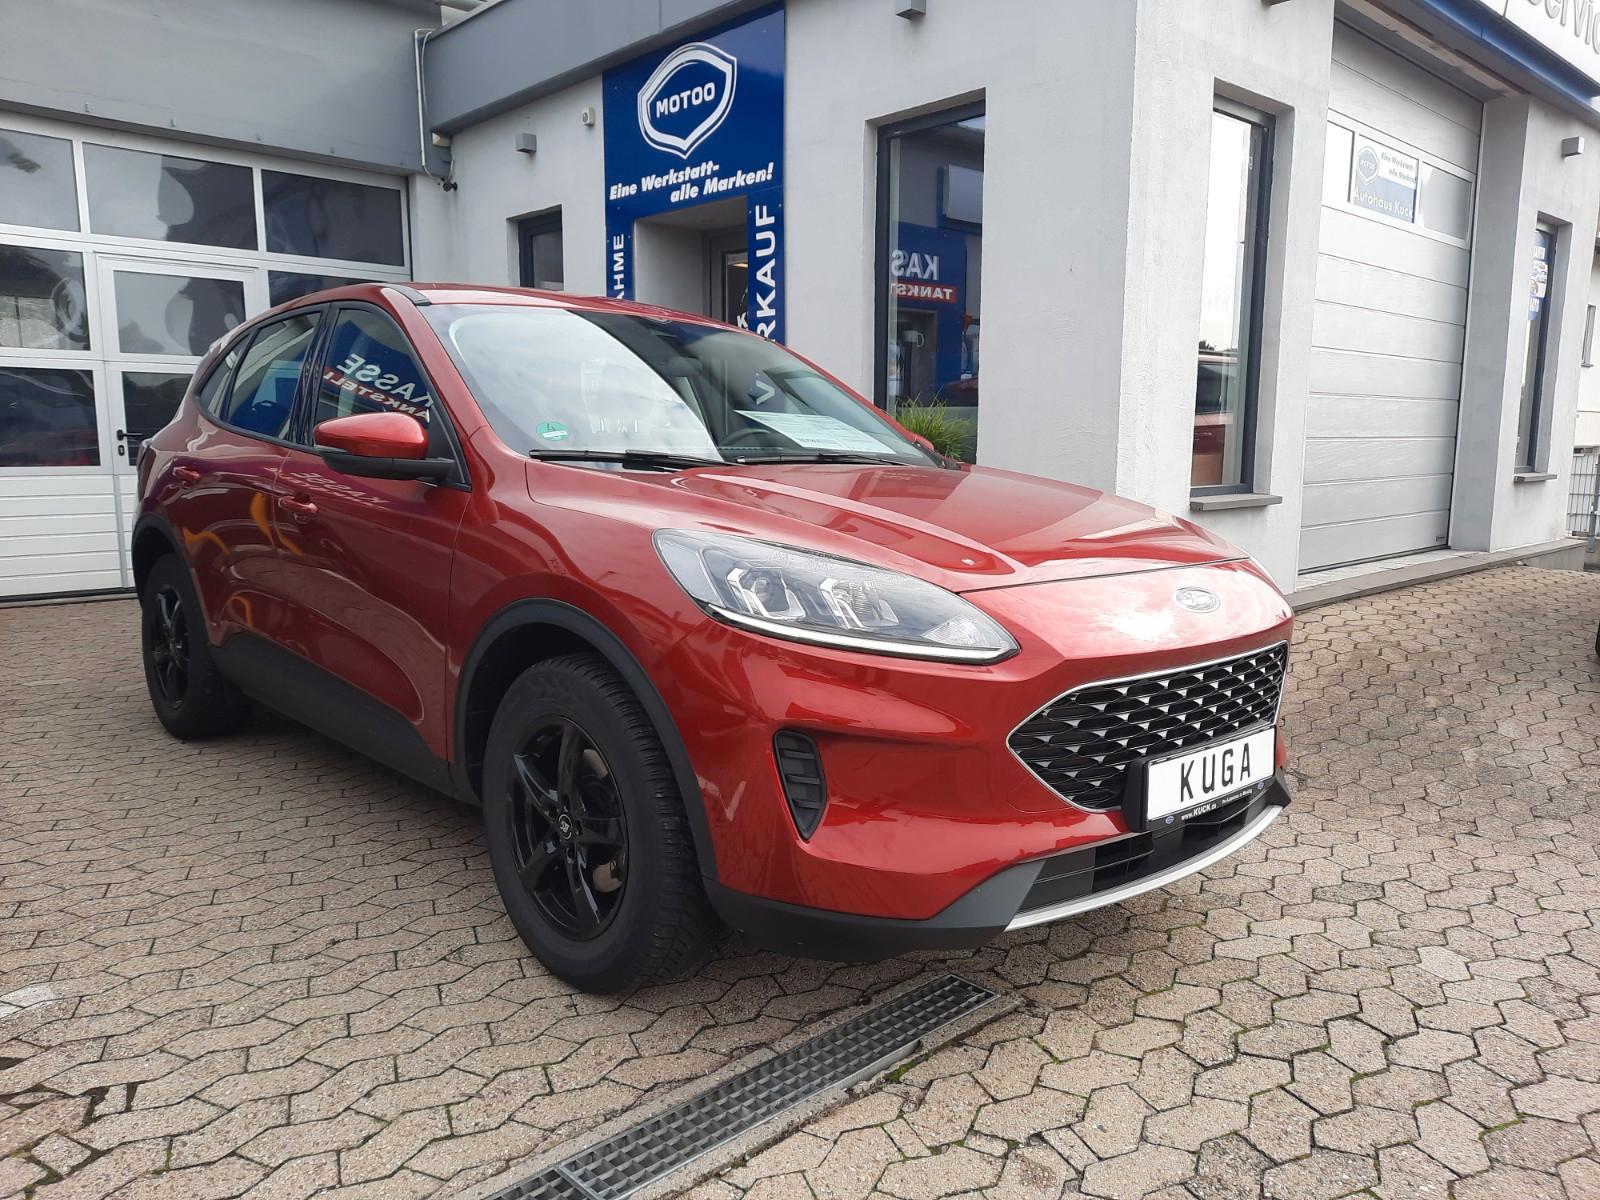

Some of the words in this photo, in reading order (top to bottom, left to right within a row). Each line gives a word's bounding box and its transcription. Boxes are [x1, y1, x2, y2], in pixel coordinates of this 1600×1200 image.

[656, 82, 716, 118] MOTOO
[609, 183, 638, 200] Eine
[641, 160, 720, 192] Werkstatt-
[670, 183, 700, 203] alle
[703, 162, 774, 195] Marken!
[1354, 187, 1392, 211] Autohaus
[1394, 200, 1413, 218] Kuck
[1180, 742, 1251, 802] KUGA
